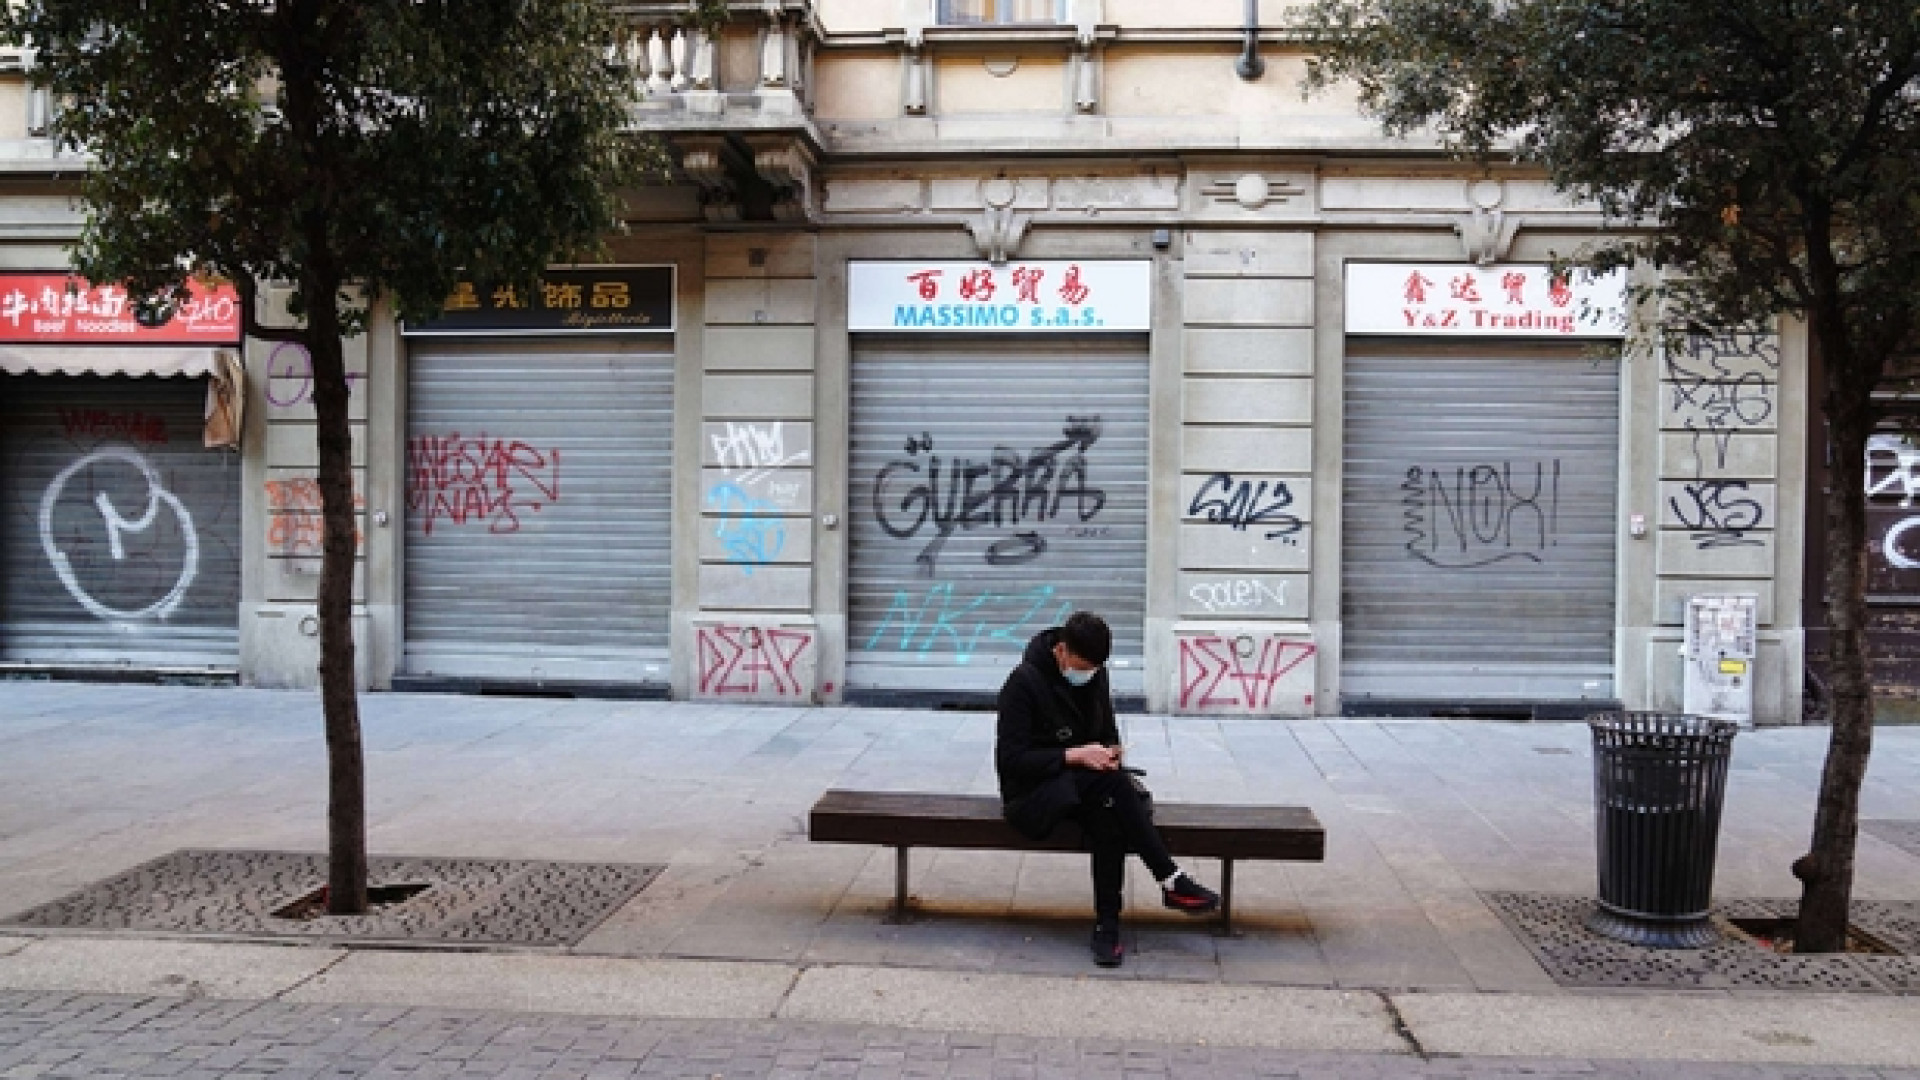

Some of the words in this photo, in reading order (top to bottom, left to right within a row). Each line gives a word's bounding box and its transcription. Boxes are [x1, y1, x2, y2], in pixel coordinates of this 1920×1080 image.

[894, 304, 1019, 326] MASSIMO
[1031, 306, 1104, 326] s.a.s.
[1403, 309, 1459, 327] Y&Z
[1470, 309, 1576, 333] Trading
